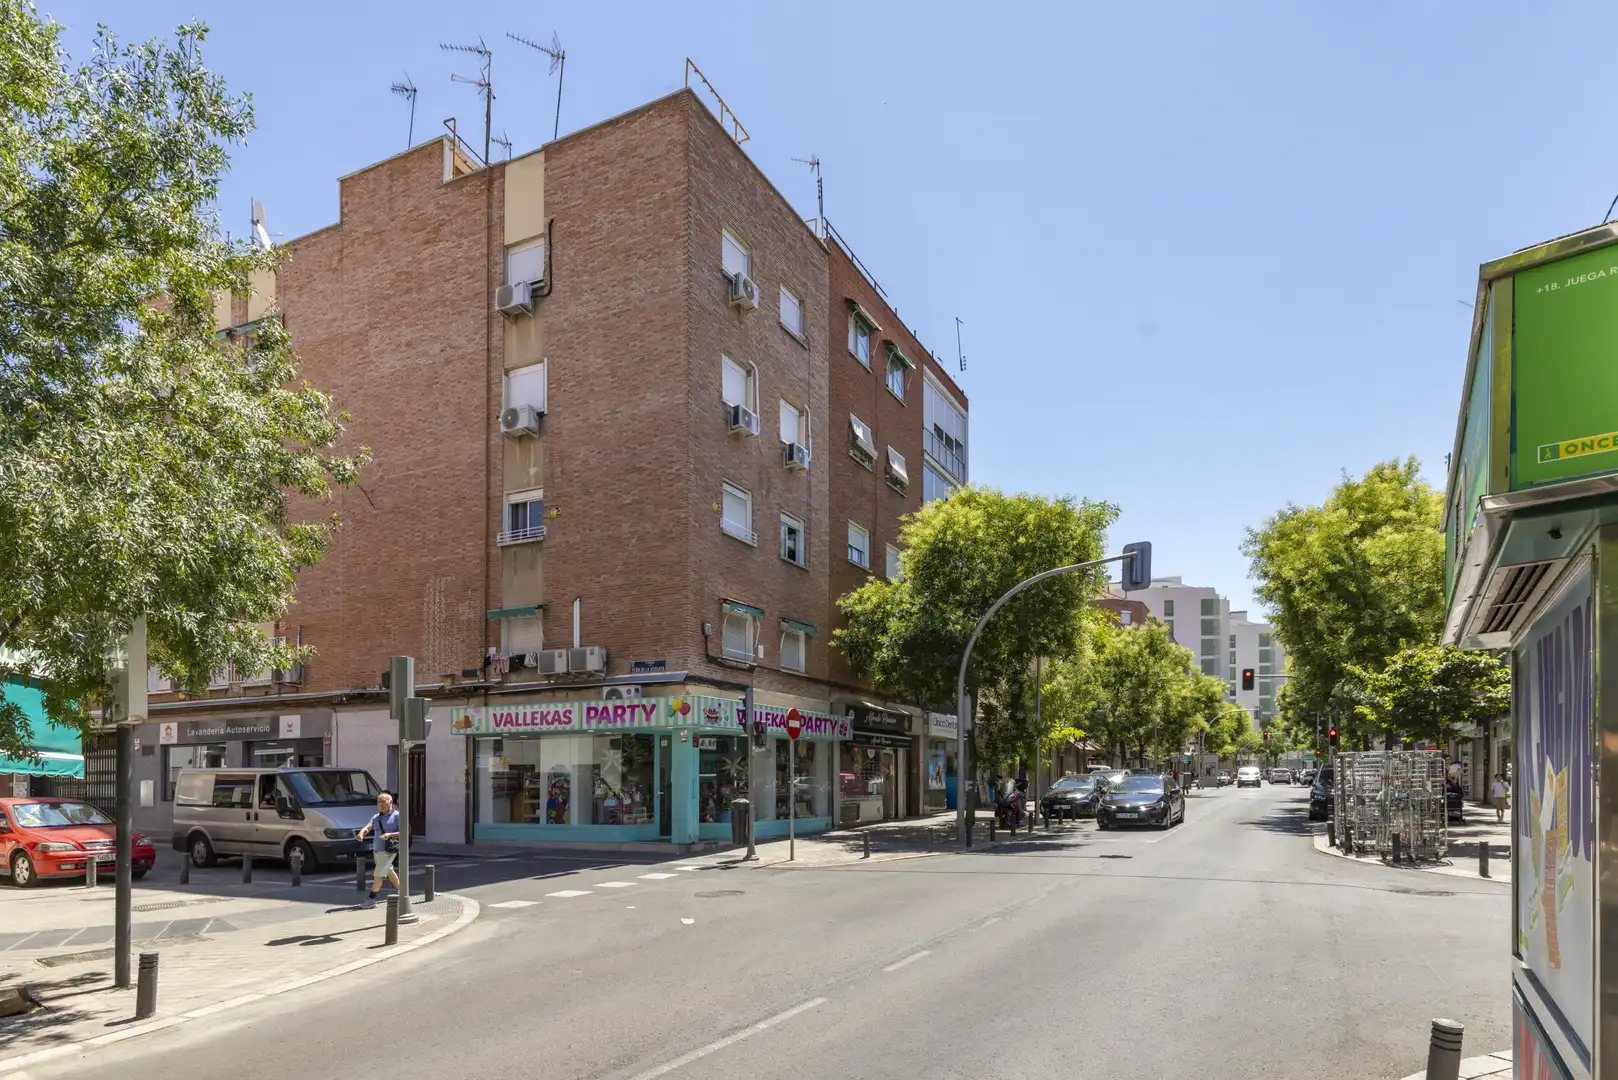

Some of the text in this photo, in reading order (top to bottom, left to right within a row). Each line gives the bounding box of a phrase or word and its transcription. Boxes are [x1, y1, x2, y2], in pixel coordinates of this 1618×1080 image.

[1536, 282, 1561, 294] +18.
[1564, 270, 1606, 287] JUEGA
[1565, 436, 1618, 454] ONCE
[493, 704, 657, 728] VALLEKAS PARTY
[800, 714, 838, 736] PARTY
[226, 725, 270, 734] Autoservicio
